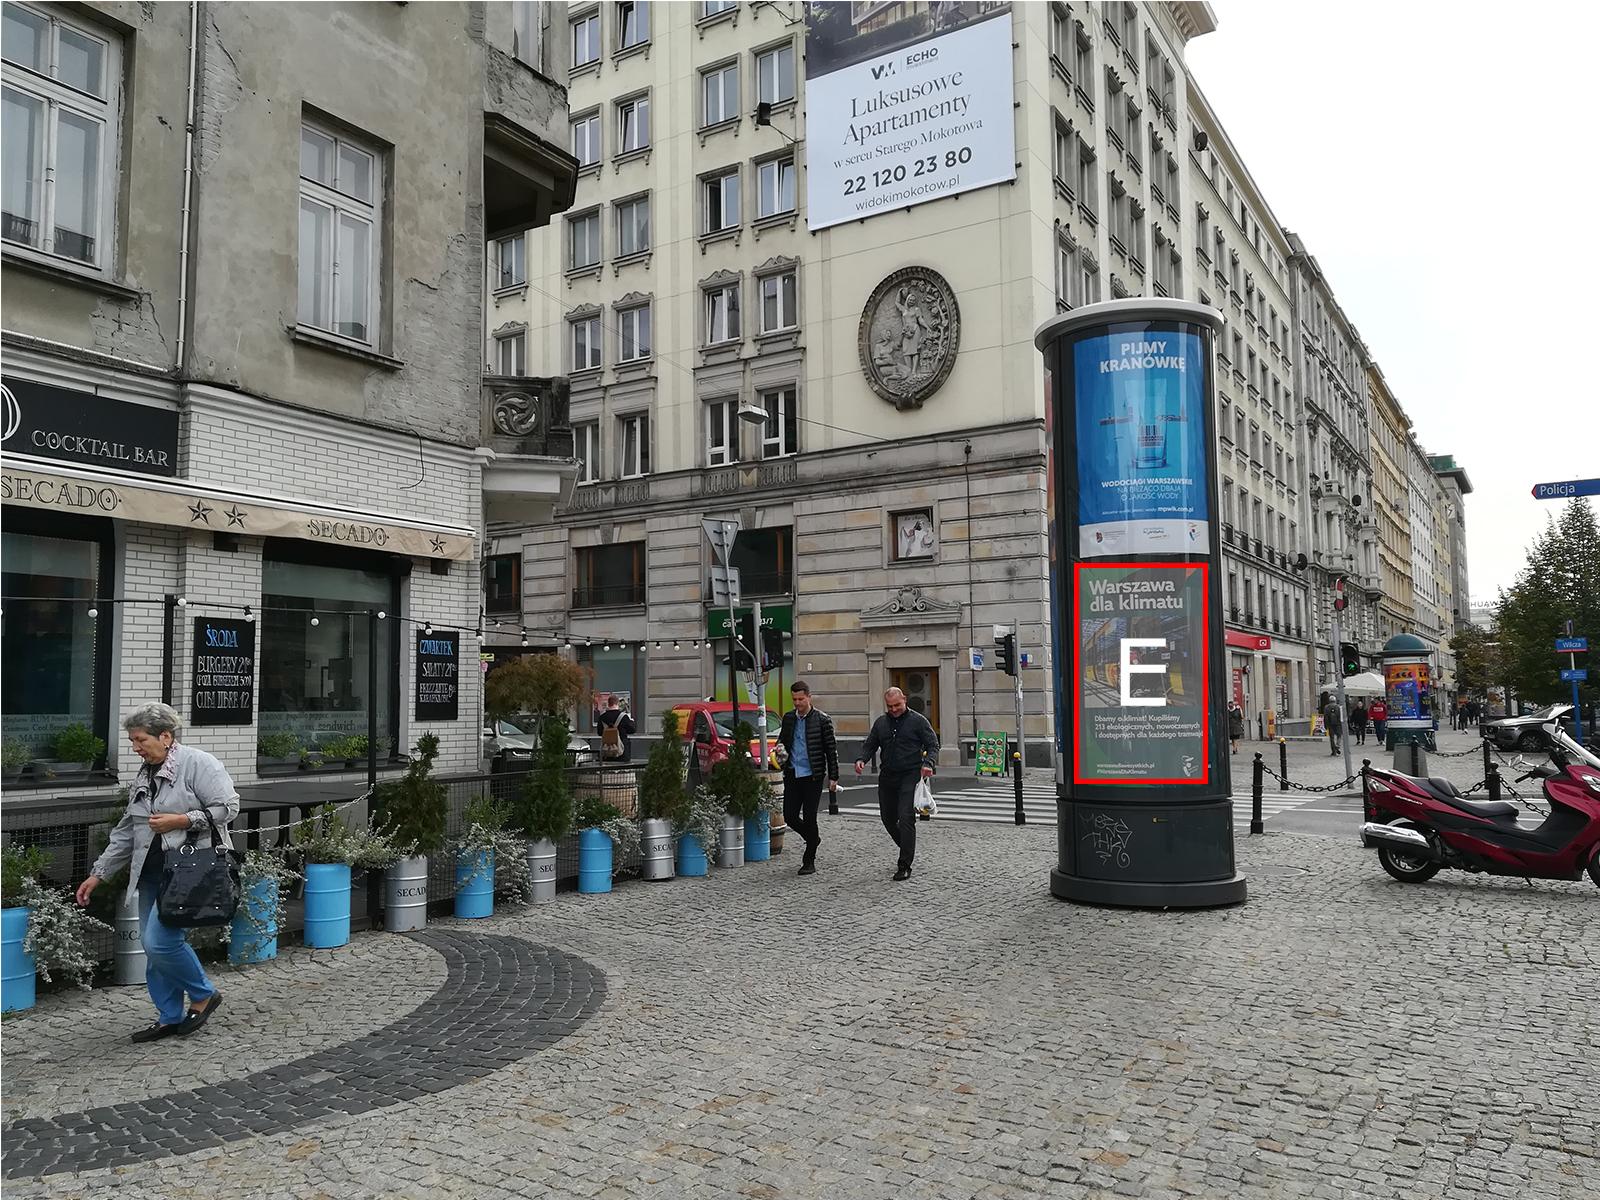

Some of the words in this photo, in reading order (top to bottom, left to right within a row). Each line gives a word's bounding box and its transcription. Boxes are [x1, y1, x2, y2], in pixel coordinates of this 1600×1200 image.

[906, 47, 938, 65] ECHO
[851, 71, 964, 118] Luksusowe
[843, 94, 971, 146] Apartamenty
[833, 160, 843, 169] w
[845, 152, 873, 167] sercu
[875, 143, 918, 158] Starego
[920, 119, 983, 144] Mokotowa
[843, 175, 866, 196] 22
[872, 165, 906, 187] 120
[914, 155, 937, 177] 23
[945, 146, 972, 168] 80
[855, 174, 961, 211] widokimokotow.pl
[1121, 341, 1167, 356] PIJMY
[1100, 353, 1185, 373] KRANÓWKĘ
[31, 430, 130, 460] COCKTAIL
[133, 446, 169, 467] BAR
[1101, 479, 1146, 489] WODOCIĄGI
[1147, 477, 1193, 486] WARSZAWSKIE
[1540, 483, 1576, 497] Policja
[0, 475, 119, 511] SECADO
[300, 519, 387, 546] SECADO
[1089, 579, 1175, 595] Warszawa
[1090, 595, 1114, 612] dla
[1119, 594, 1183, 610] klimatu
[206, 624, 238, 647] ŚRODA
[198, 656, 238, 673] BURGERY
[319, 720, 355, 730] sandwich
[1094, 715, 1116, 723] Dbamy
[1156, 722, 1200, 730] nowoczesnych
[1148, 731, 1177, 739] każdego
